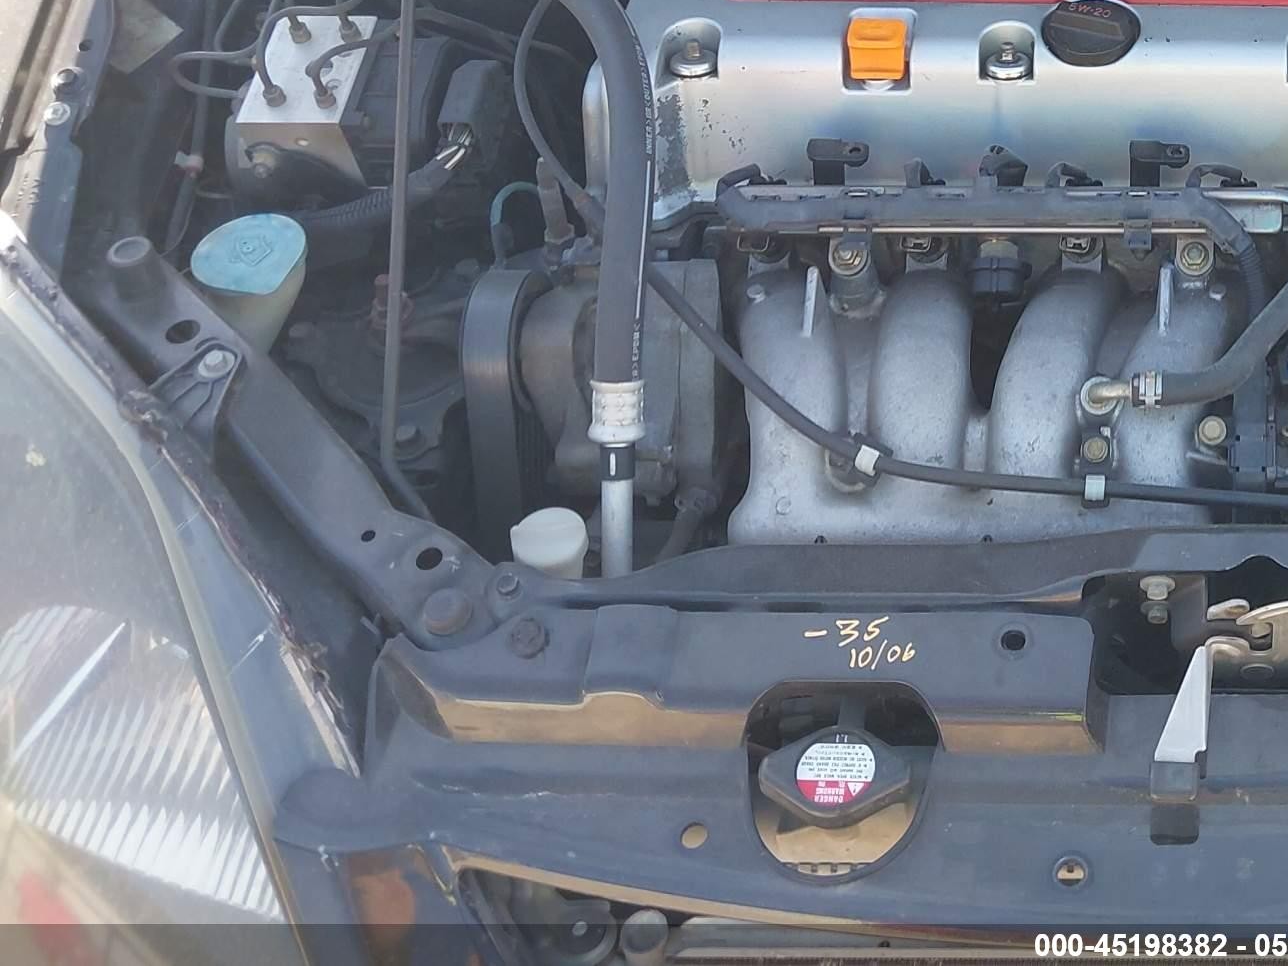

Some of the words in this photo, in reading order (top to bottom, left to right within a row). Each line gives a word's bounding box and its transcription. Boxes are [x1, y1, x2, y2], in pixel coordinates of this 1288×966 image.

[1068, 2, 1112, 19] 5W-20
[849, 638, 916, 671] 10/06
[815, 787, 845, 796] WARNING
[814, 795, 844, 804] DANGER
